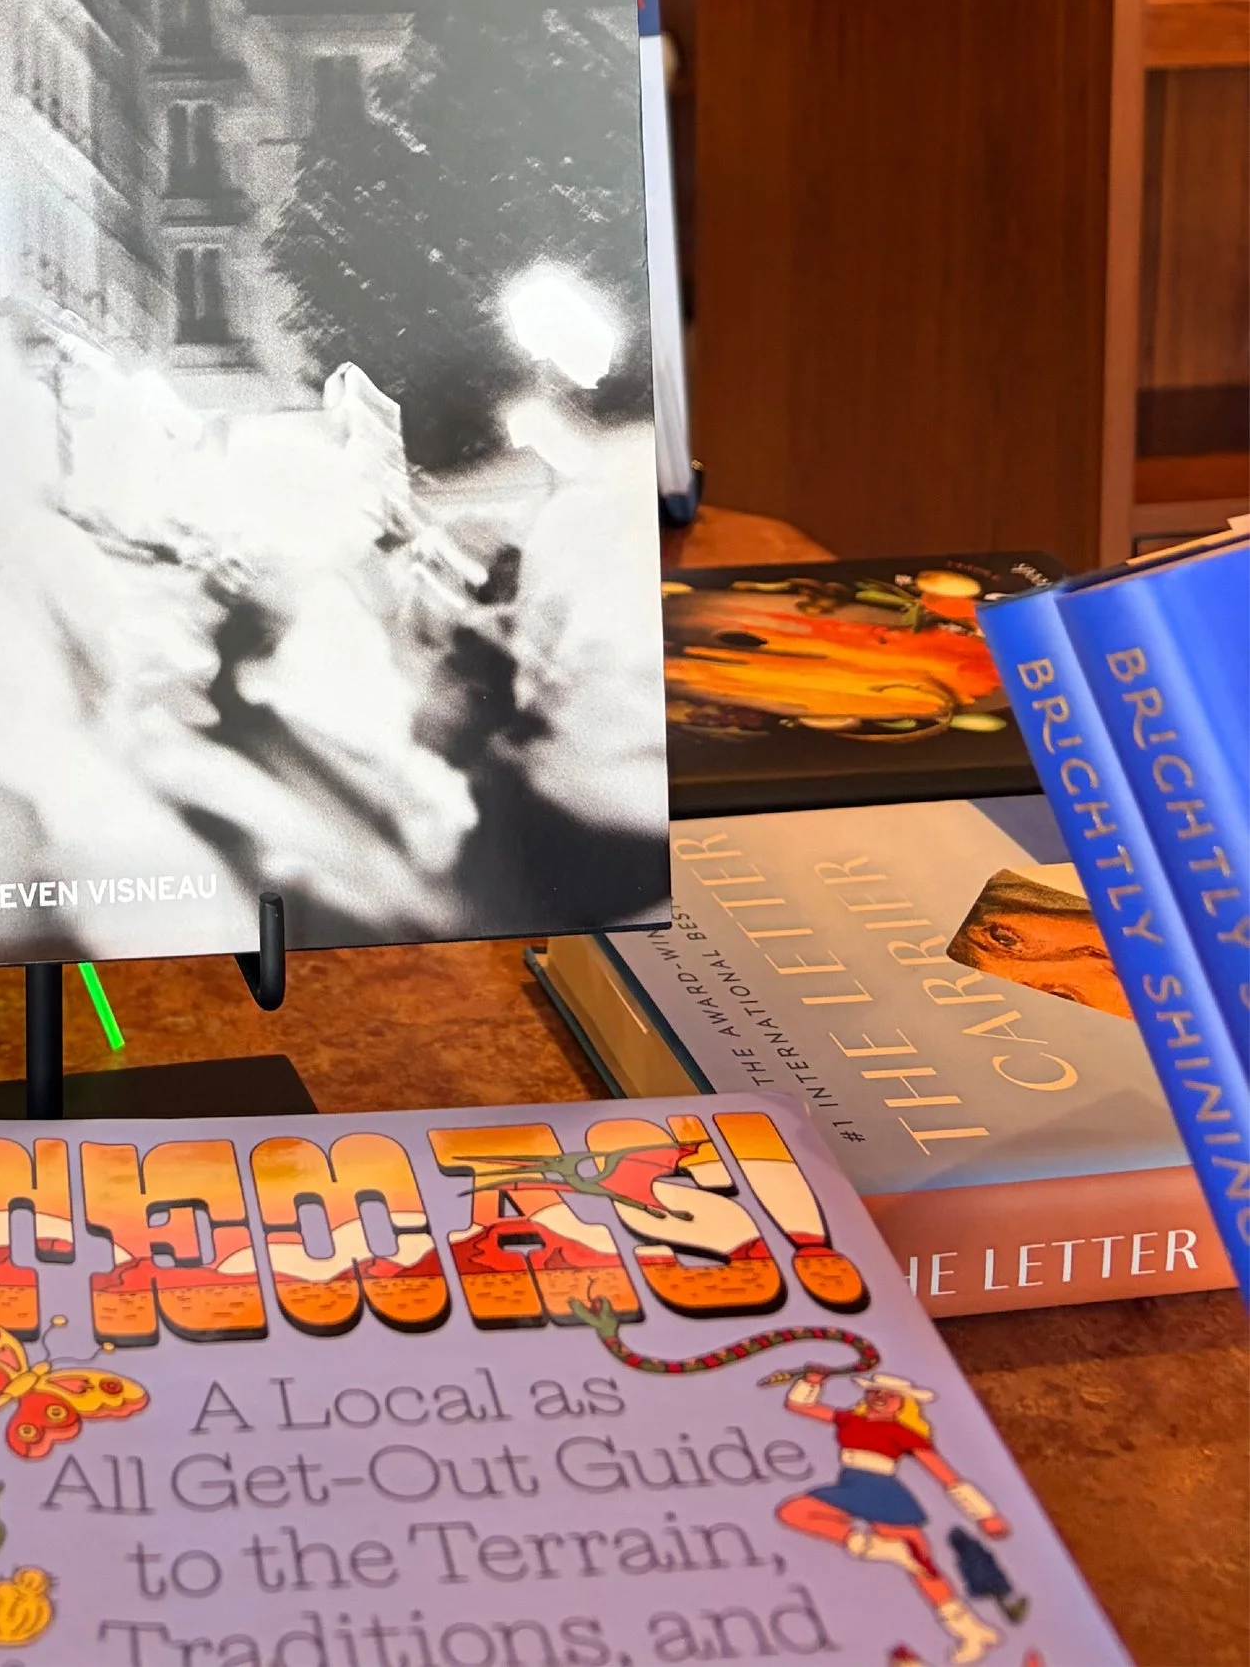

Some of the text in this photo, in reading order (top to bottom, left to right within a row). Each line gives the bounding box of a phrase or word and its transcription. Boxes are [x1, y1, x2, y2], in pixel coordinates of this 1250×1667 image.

[86, 873, 218, 905] VISNEAU
[671, 832, 990, 1157] THE LETTER
[813, 855, 1079, 1092] CARRIER
[702, 948, 839, 1108] INTERNATIONAL
[732, 1047, 775, 1086] THE
[832, 1120, 867, 1143] #1
[983, 1228, 1199, 1291] LETTER
[188, 1369, 626, 1434] A Local as
[40, 1426, 817, 1515] All Get-Out Guide
[126, 1511, 788, 1599] to the Terrain,
[98, 1582, 843, 1667] Traditions, and
